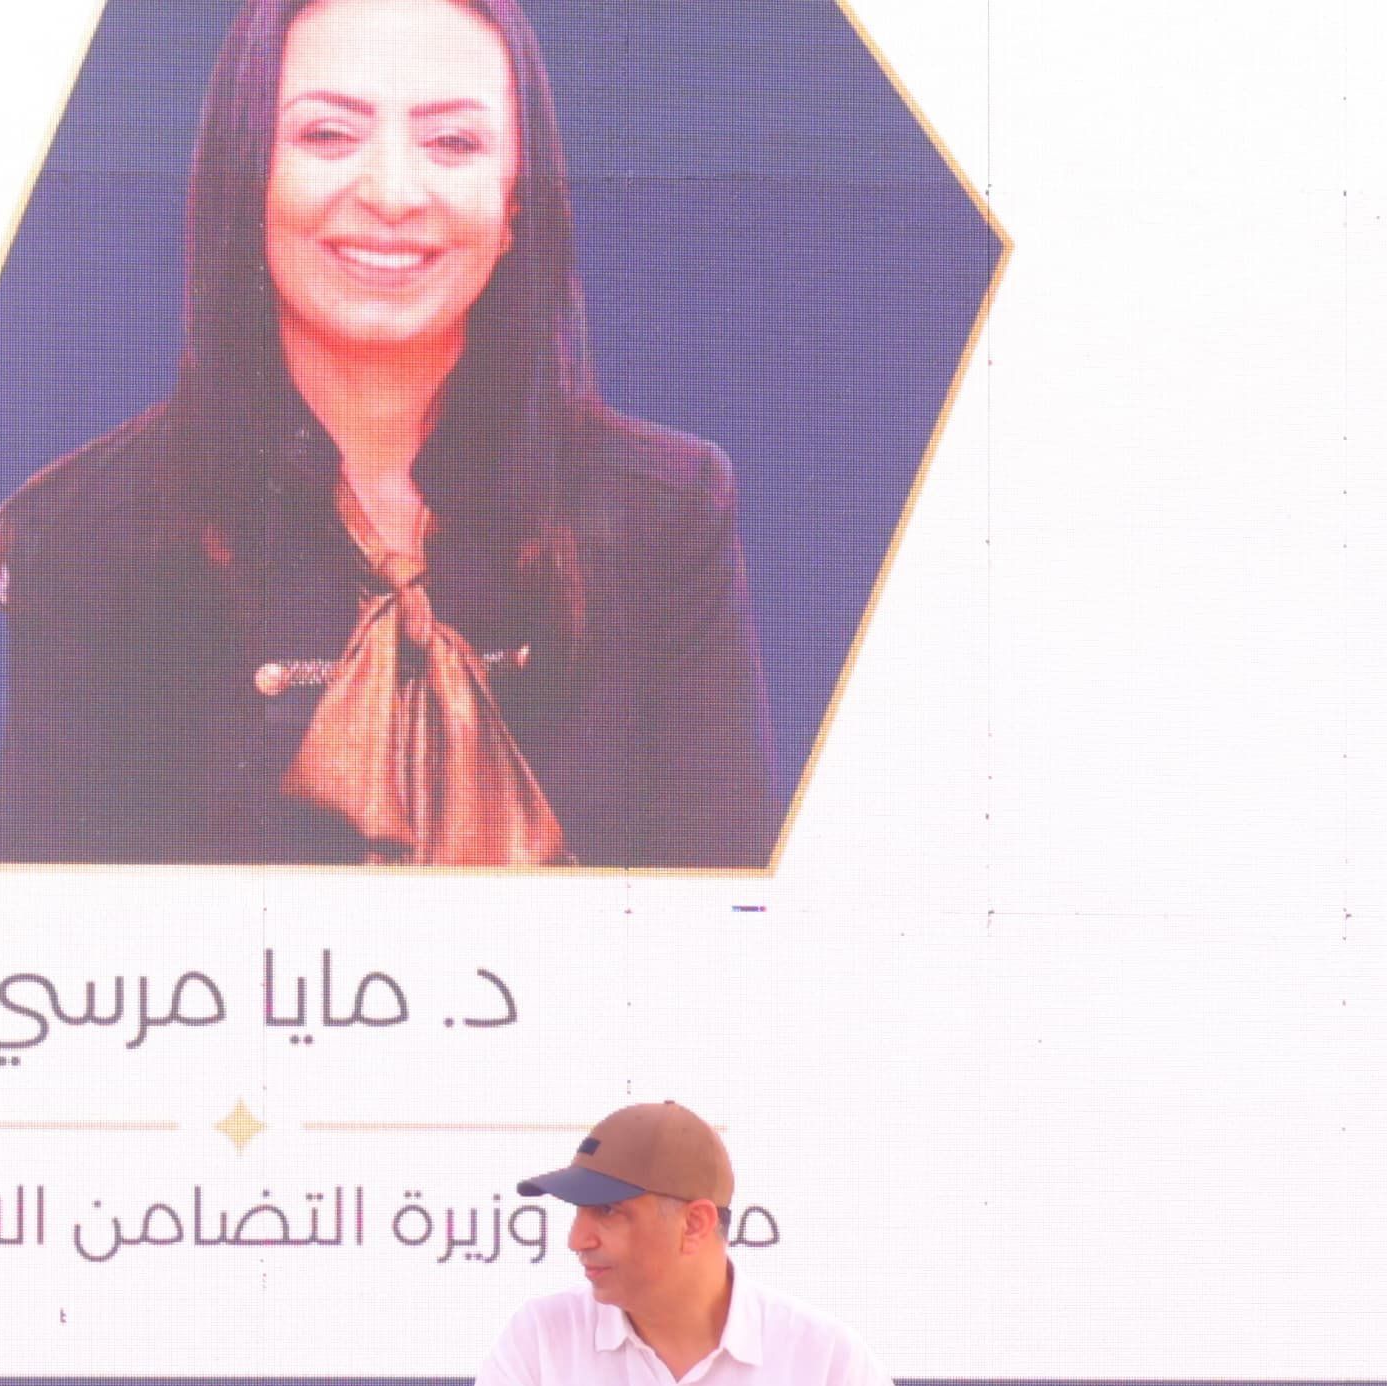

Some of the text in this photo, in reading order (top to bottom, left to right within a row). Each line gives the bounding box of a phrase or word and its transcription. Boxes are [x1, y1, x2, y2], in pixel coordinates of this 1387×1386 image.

[262, 947, 410, 1046] مايا
[443, 968, 518, 1029] د.
[73, 1185, 364, 1264] التضامن
[392, 1193, 549, 1265] وزيرة
